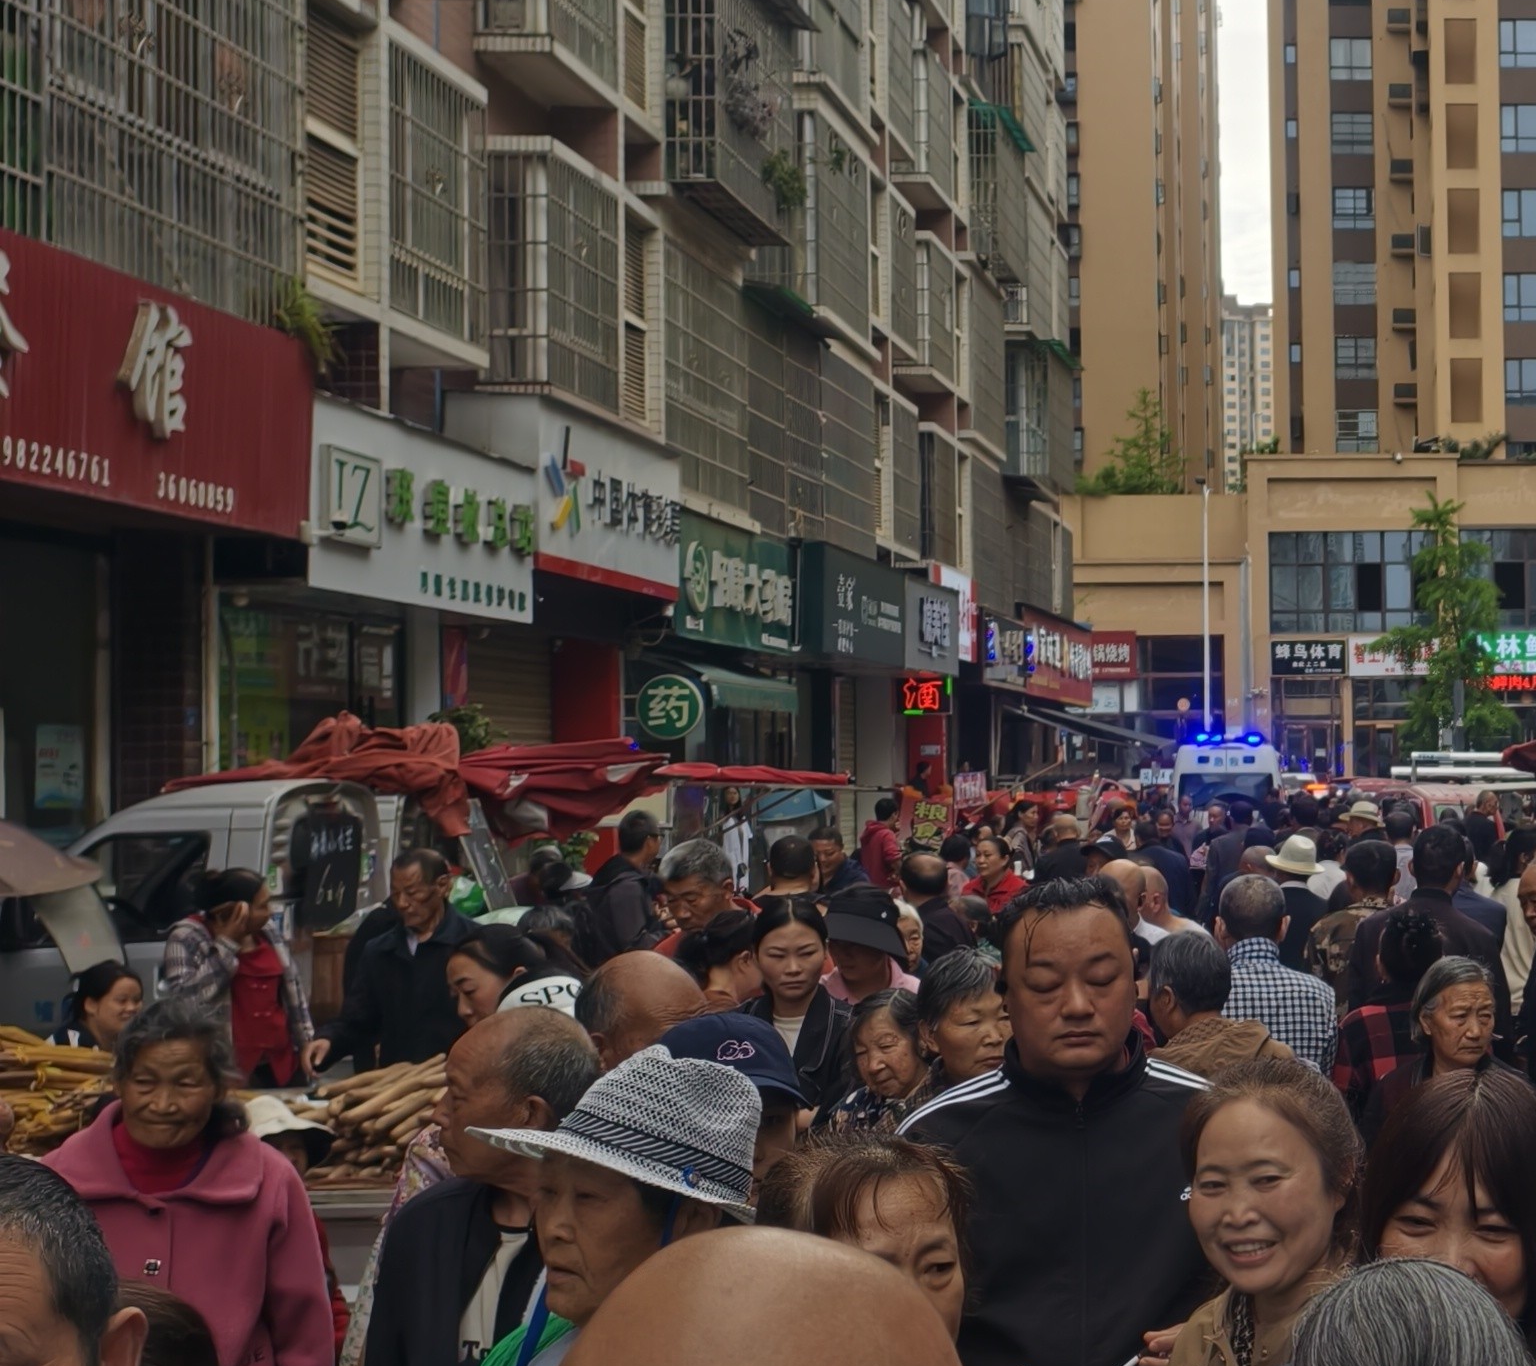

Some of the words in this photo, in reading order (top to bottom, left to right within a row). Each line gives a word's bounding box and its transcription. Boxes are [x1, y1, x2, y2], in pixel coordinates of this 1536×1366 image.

[1275, 643, 1343, 660] 蜂鸟体育
[647, 685, 691, 730] 药
[903, 678, 943, 709] 酒
